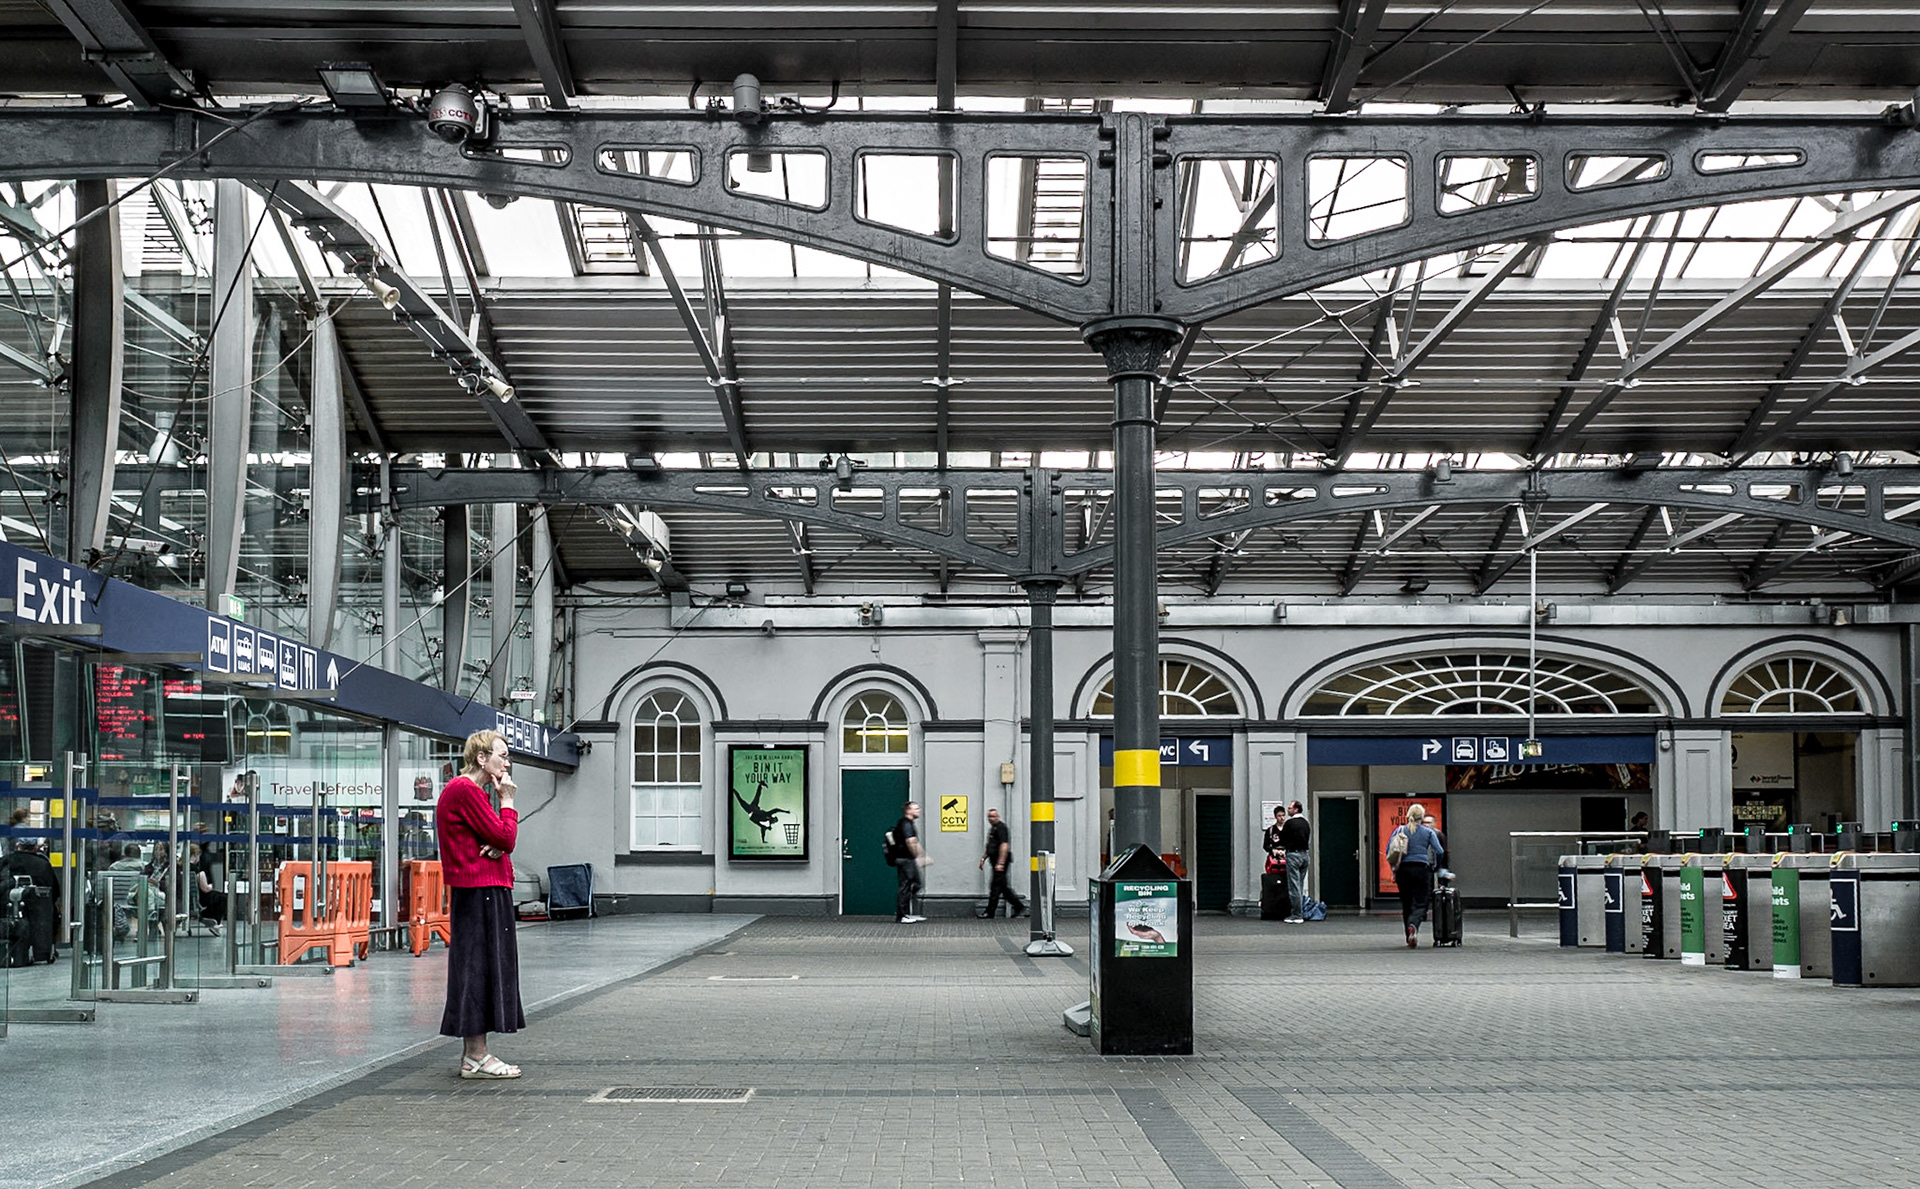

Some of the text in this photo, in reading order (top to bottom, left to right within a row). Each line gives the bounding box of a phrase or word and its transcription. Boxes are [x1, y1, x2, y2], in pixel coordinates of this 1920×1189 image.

[17, 557, 85, 624] Exit
[211, 636, 227, 655] ATM
[753, 762, 783, 773] BIN IT
[1490, 763, 1575, 779] HOTE
[745, 773, 791, 783] YOUR WAY
[270, 781, 383, 795] Trave efreshe
[942, 816, 966, 824] CCTV
